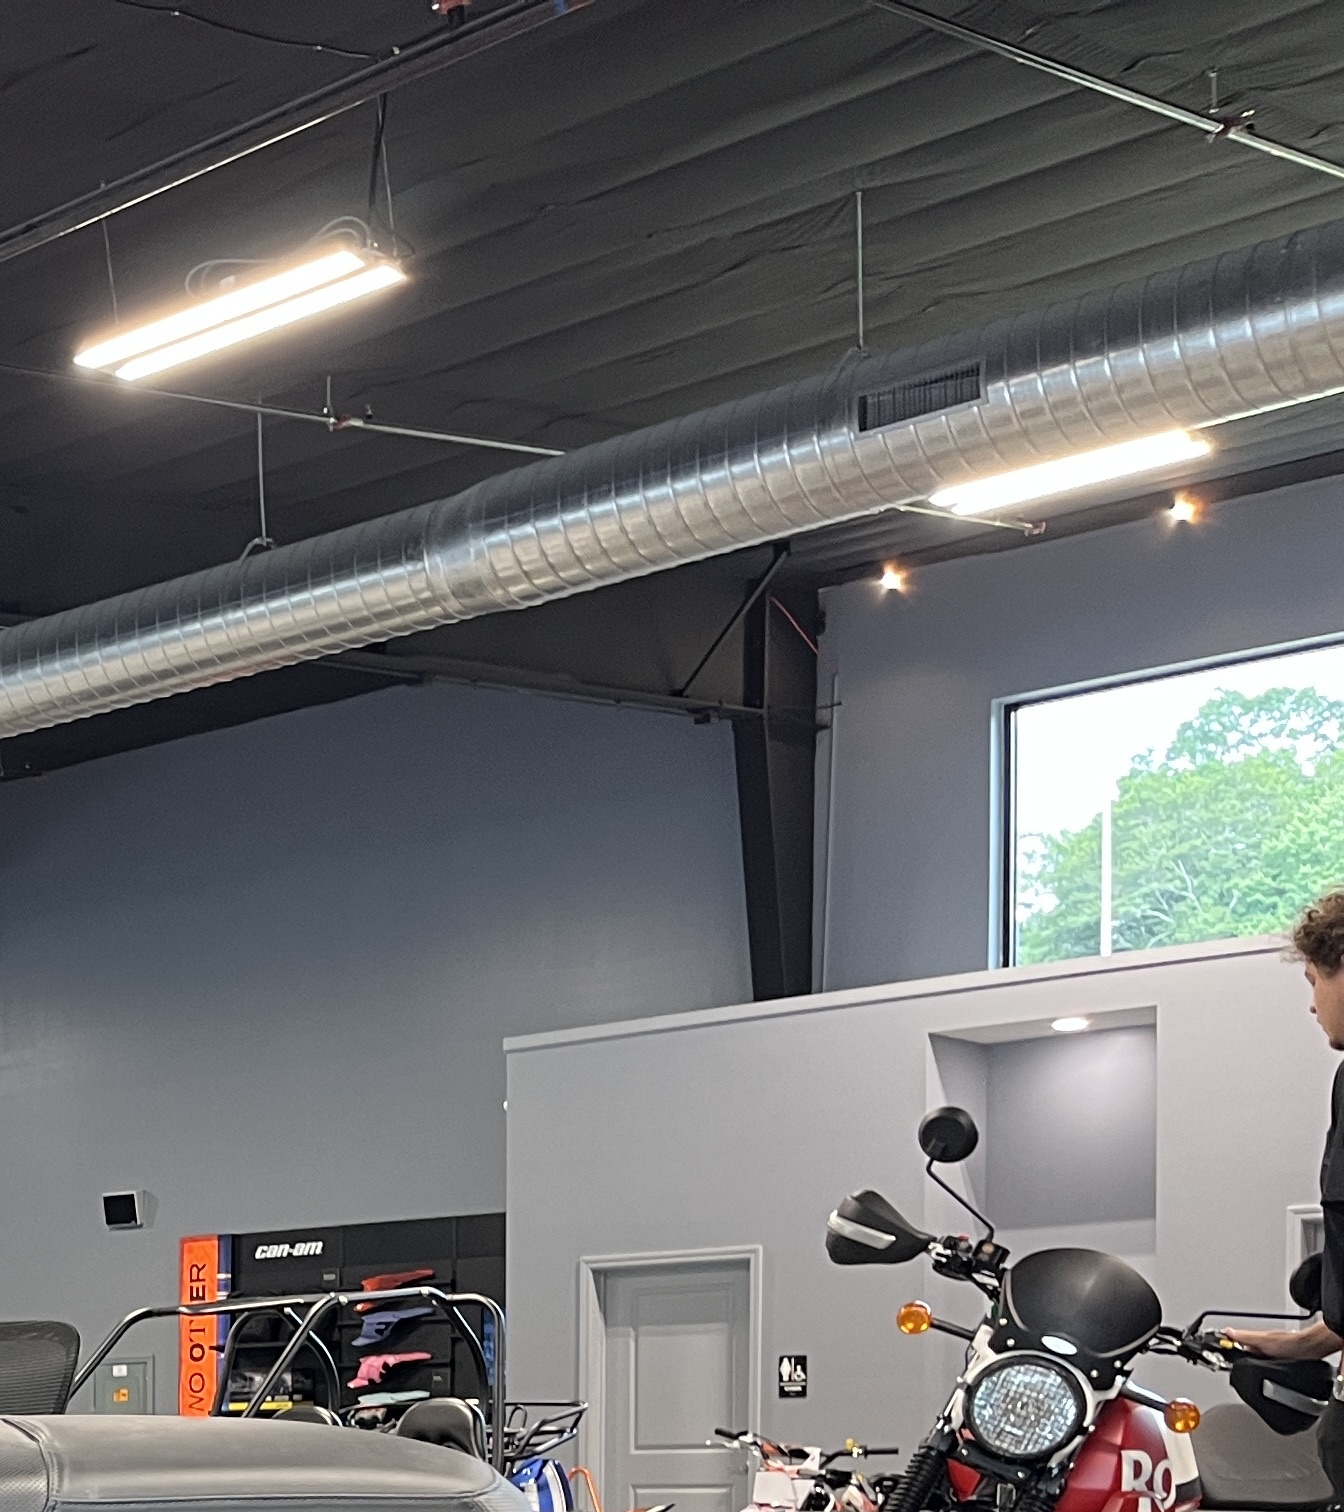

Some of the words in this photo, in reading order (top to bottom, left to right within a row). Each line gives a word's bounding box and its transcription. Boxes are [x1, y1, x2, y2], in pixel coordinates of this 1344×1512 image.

[254, 1240, 324, 1260] can-am
[188, 1263, 207, 1362] OTER
[188, 1372, 206, 1412] NO
